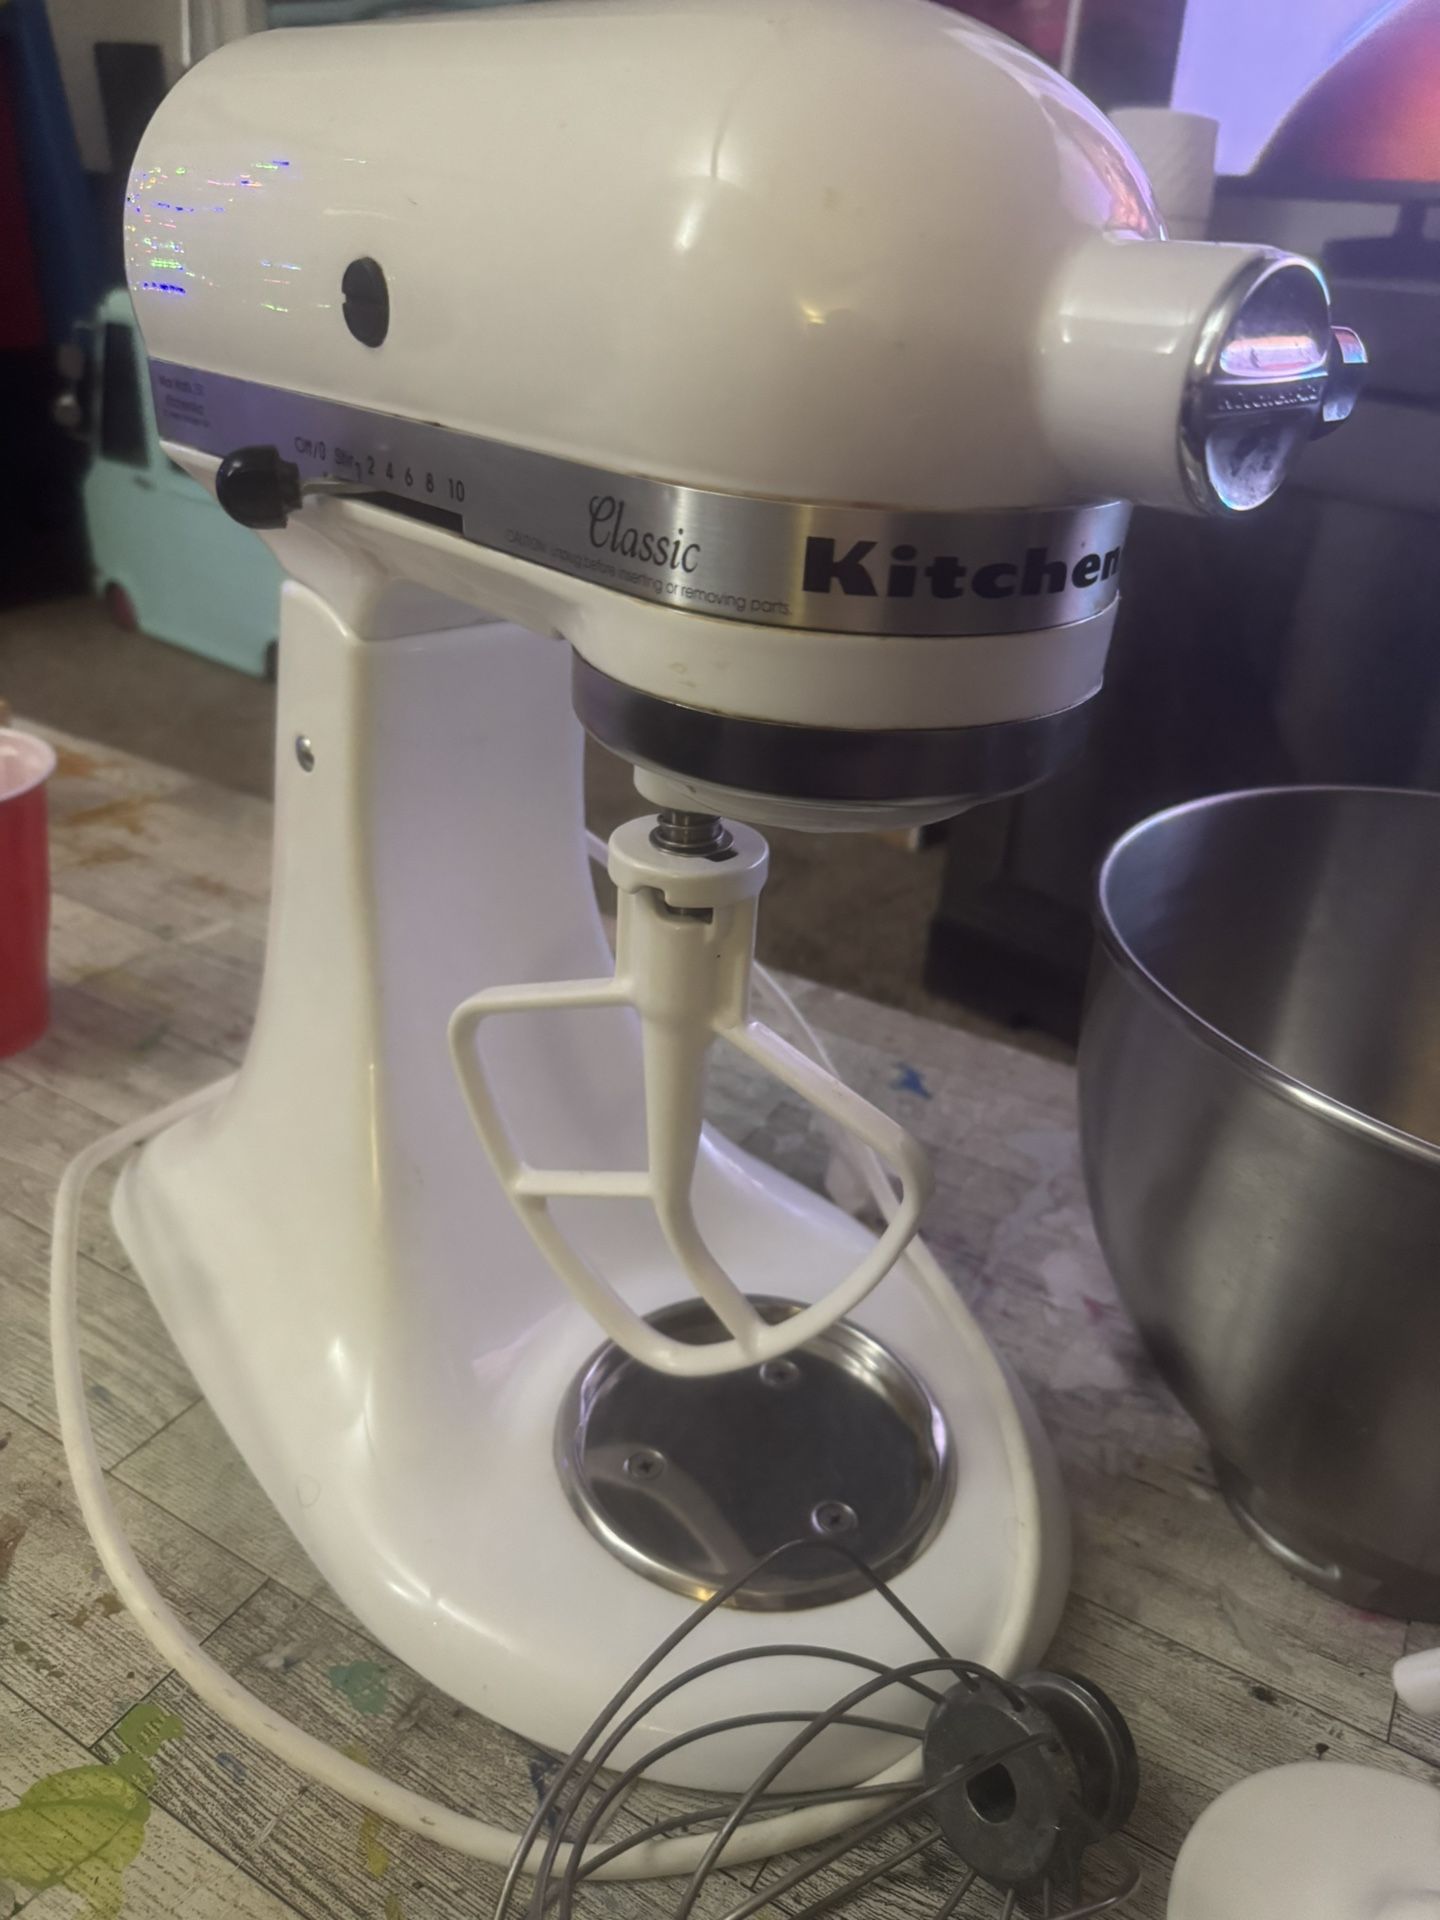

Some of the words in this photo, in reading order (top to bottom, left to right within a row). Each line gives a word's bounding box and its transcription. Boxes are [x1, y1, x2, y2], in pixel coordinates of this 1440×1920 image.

[367, 455, 376, 476] 2
[385, 460, 395, 480] 4
[404, 466, 414, 487] 6
[425, 472, 435, 493] 8
[448, 478, 465, 503] 10
[589, 495, 701, 573] Classic
[802, 536, 1120, 600] Kitchen
[682, 585, 747, 612] removing
